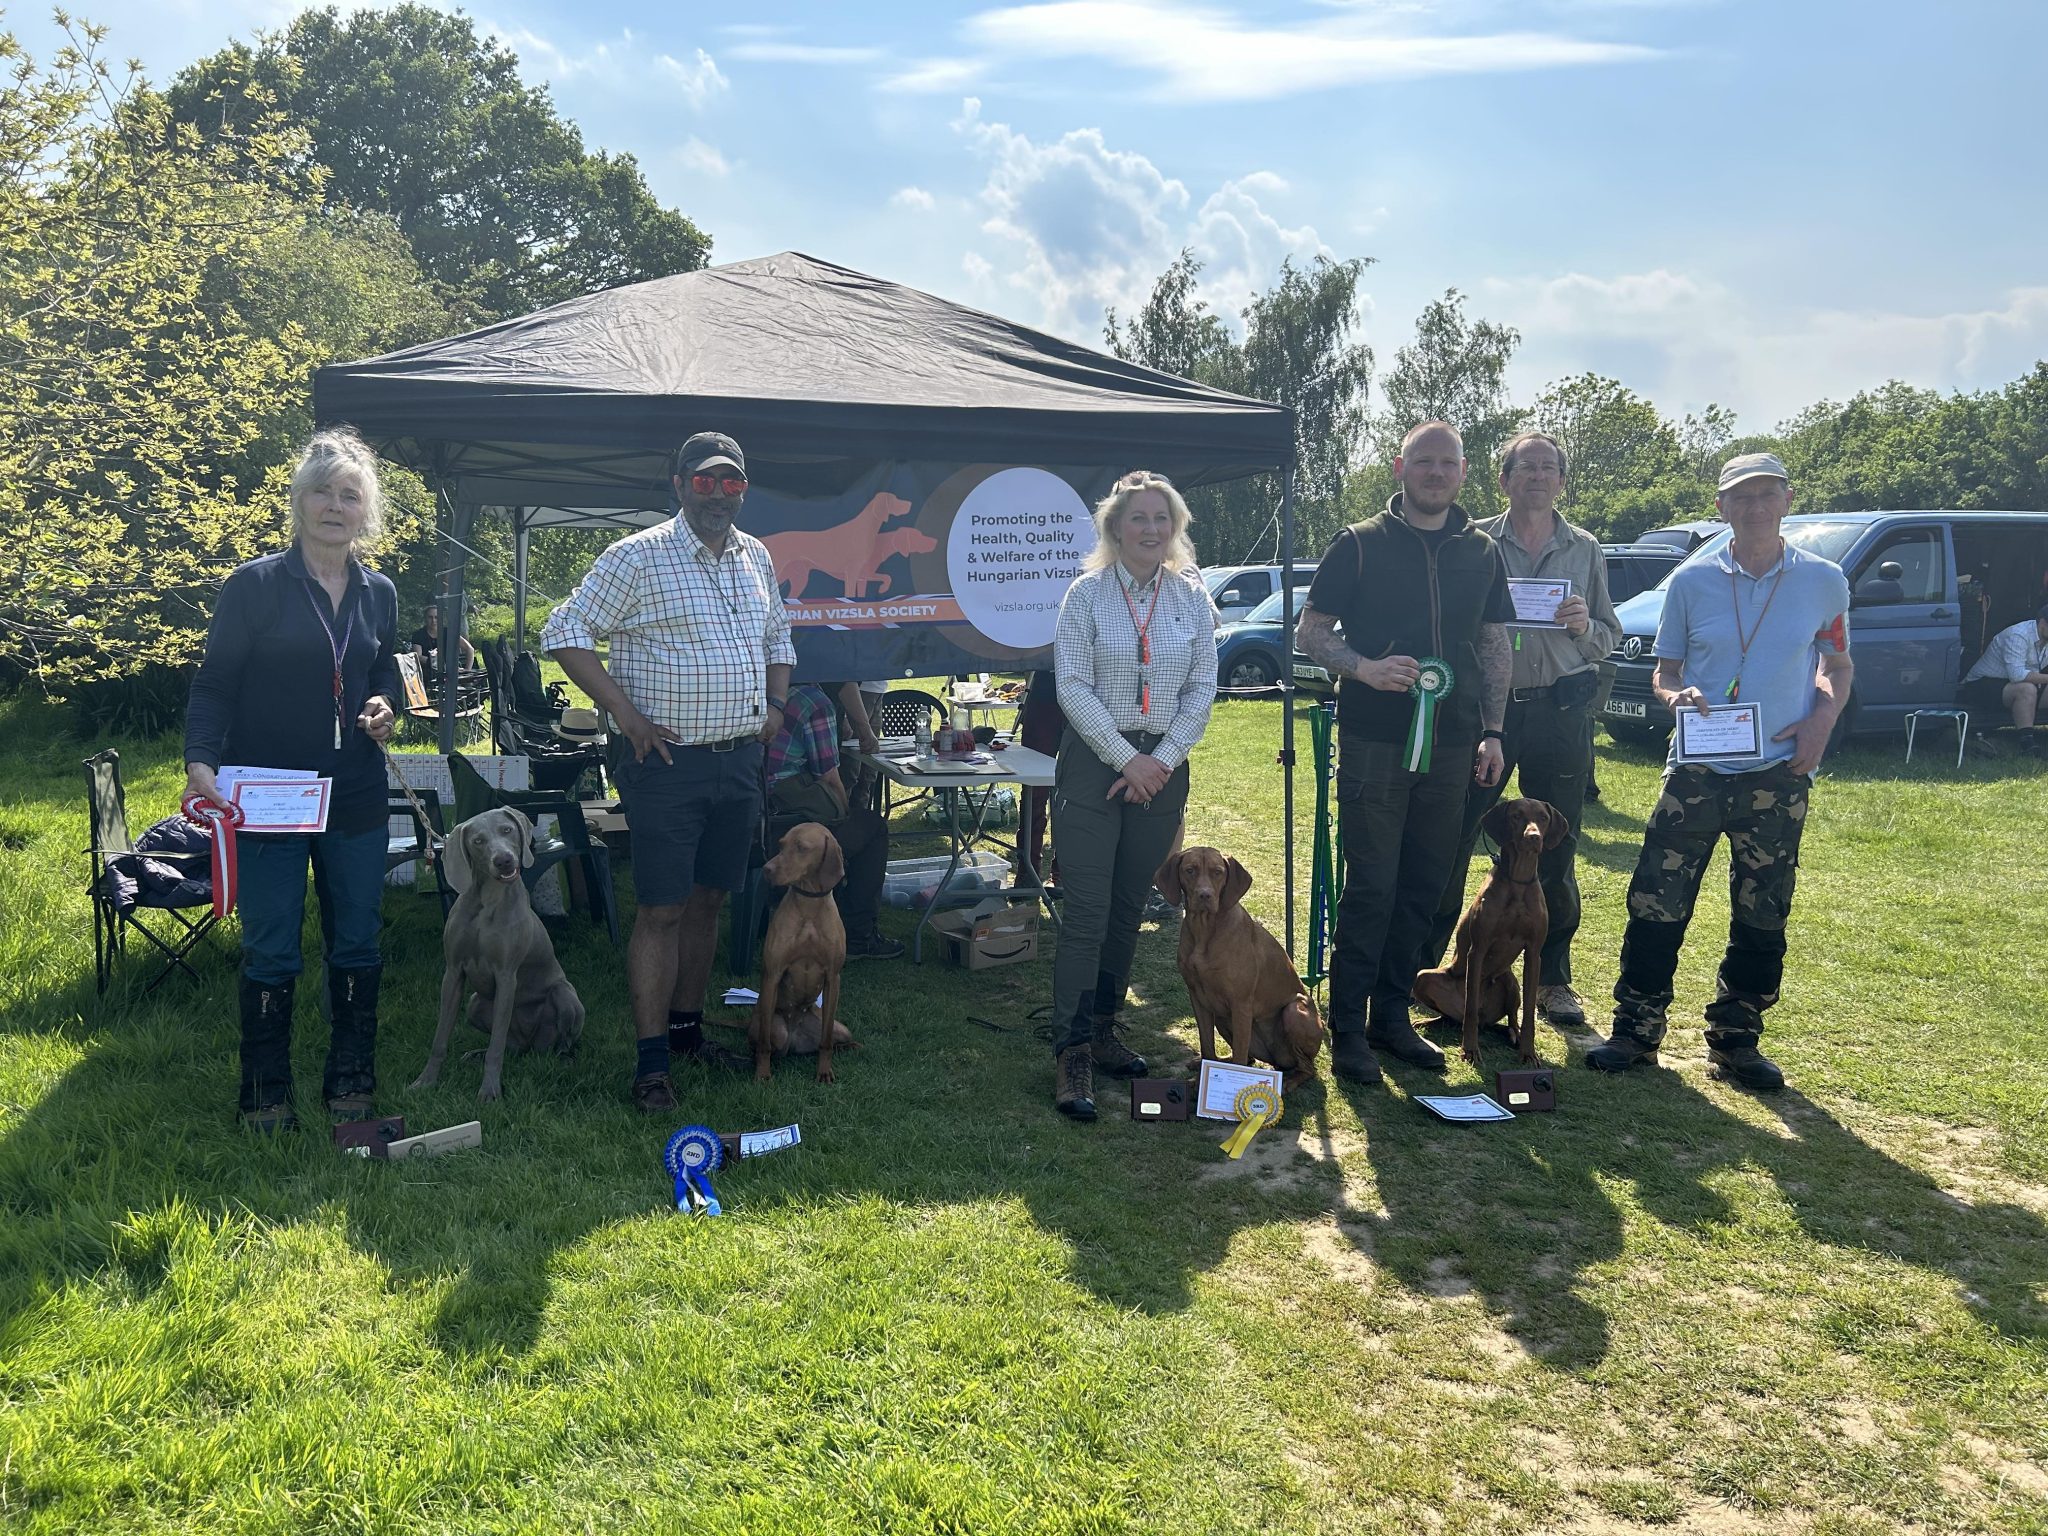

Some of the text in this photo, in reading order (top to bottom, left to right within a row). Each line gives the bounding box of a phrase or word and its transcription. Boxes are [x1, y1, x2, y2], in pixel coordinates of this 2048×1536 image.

[971, 512, 1073, 526] Promoting the
[971, 530, 1074, 545] Health, Quality
[967, 549, 1079, 563] & Welfare of the
[967, 567, 1085, 584] Hungarian Vizsla
[826, 606, 876, 620] VIZSLA
[879, 605, 937, 618] SOCIETY
[994, 600, 1060, 613] vizsla.org.uk
[1624, 702, 1643, 715] NWC
